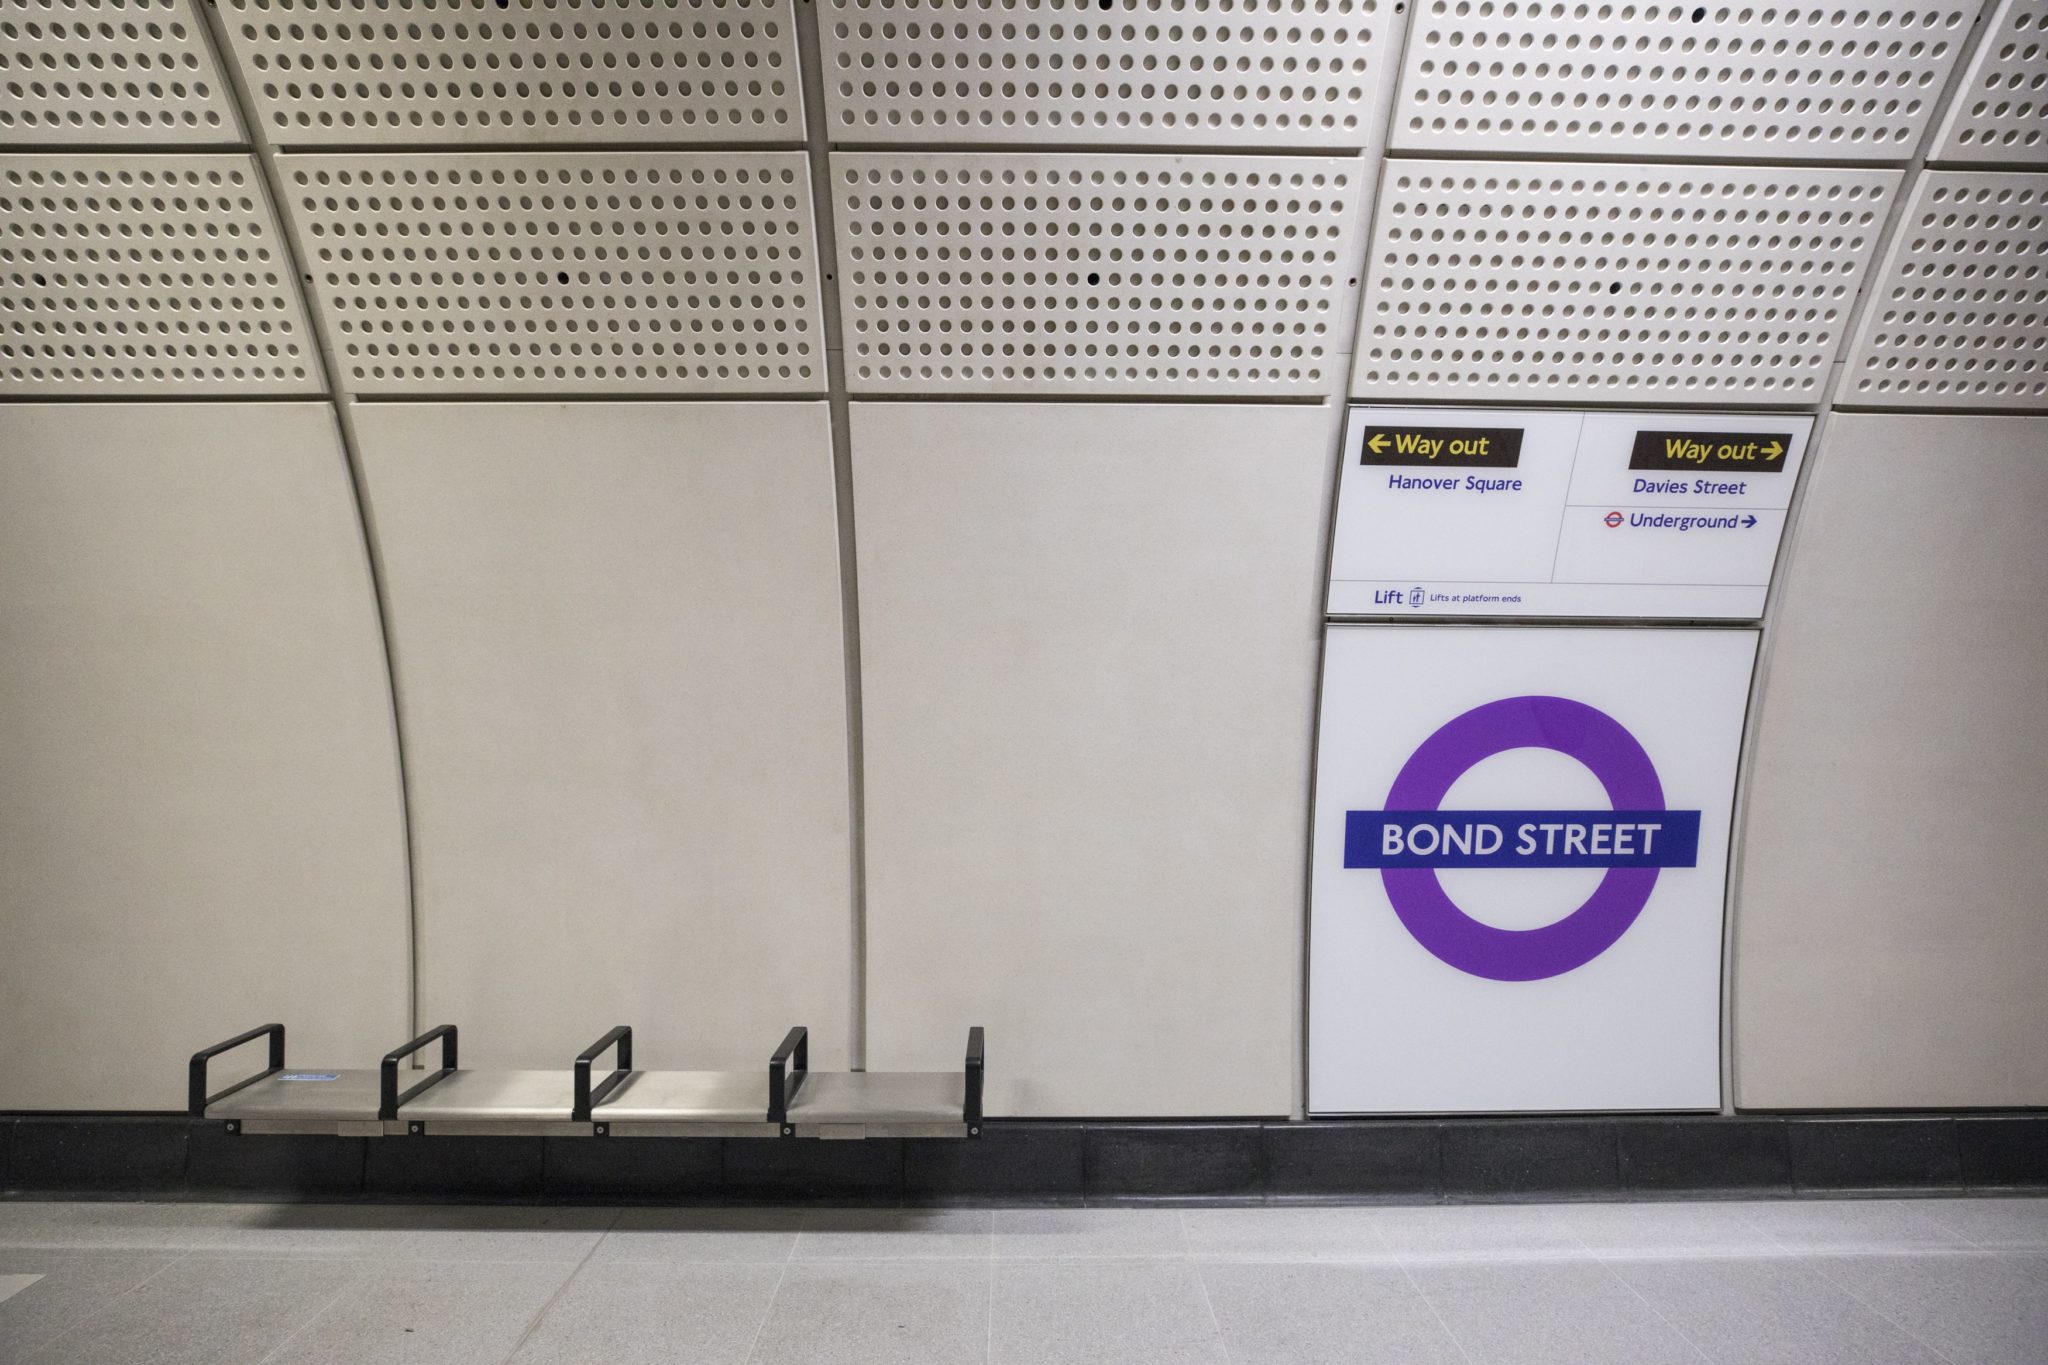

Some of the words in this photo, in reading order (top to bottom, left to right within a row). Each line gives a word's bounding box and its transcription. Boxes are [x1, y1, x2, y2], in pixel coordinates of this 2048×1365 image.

[1395, 432, 1445, 459] Way
[1447, 437, 1489, 456] out
[1665, 438, 1713, 464] Way
[1716, 443, 1758, 461] out
[1389, 474, 1461, 490] Hanover
[1465, 475, 1523, 493] Square
[1633, 478, 1689, 494] Davies
[1692, 479, 1748, 495] Street
[1630, 512, 1738, 531] Underground
[1374, 589, 1404, 604] Lift
[1429, 593, 1450, 602] Lifts
[1451, 594, 1461, 602] at
[1462, 594, 1500, 604] platform
[1501, 594, 1522, 603] ends
[1382, 823, 1504, 856] BOND
[1515, 823, 1662, 856] STREET
